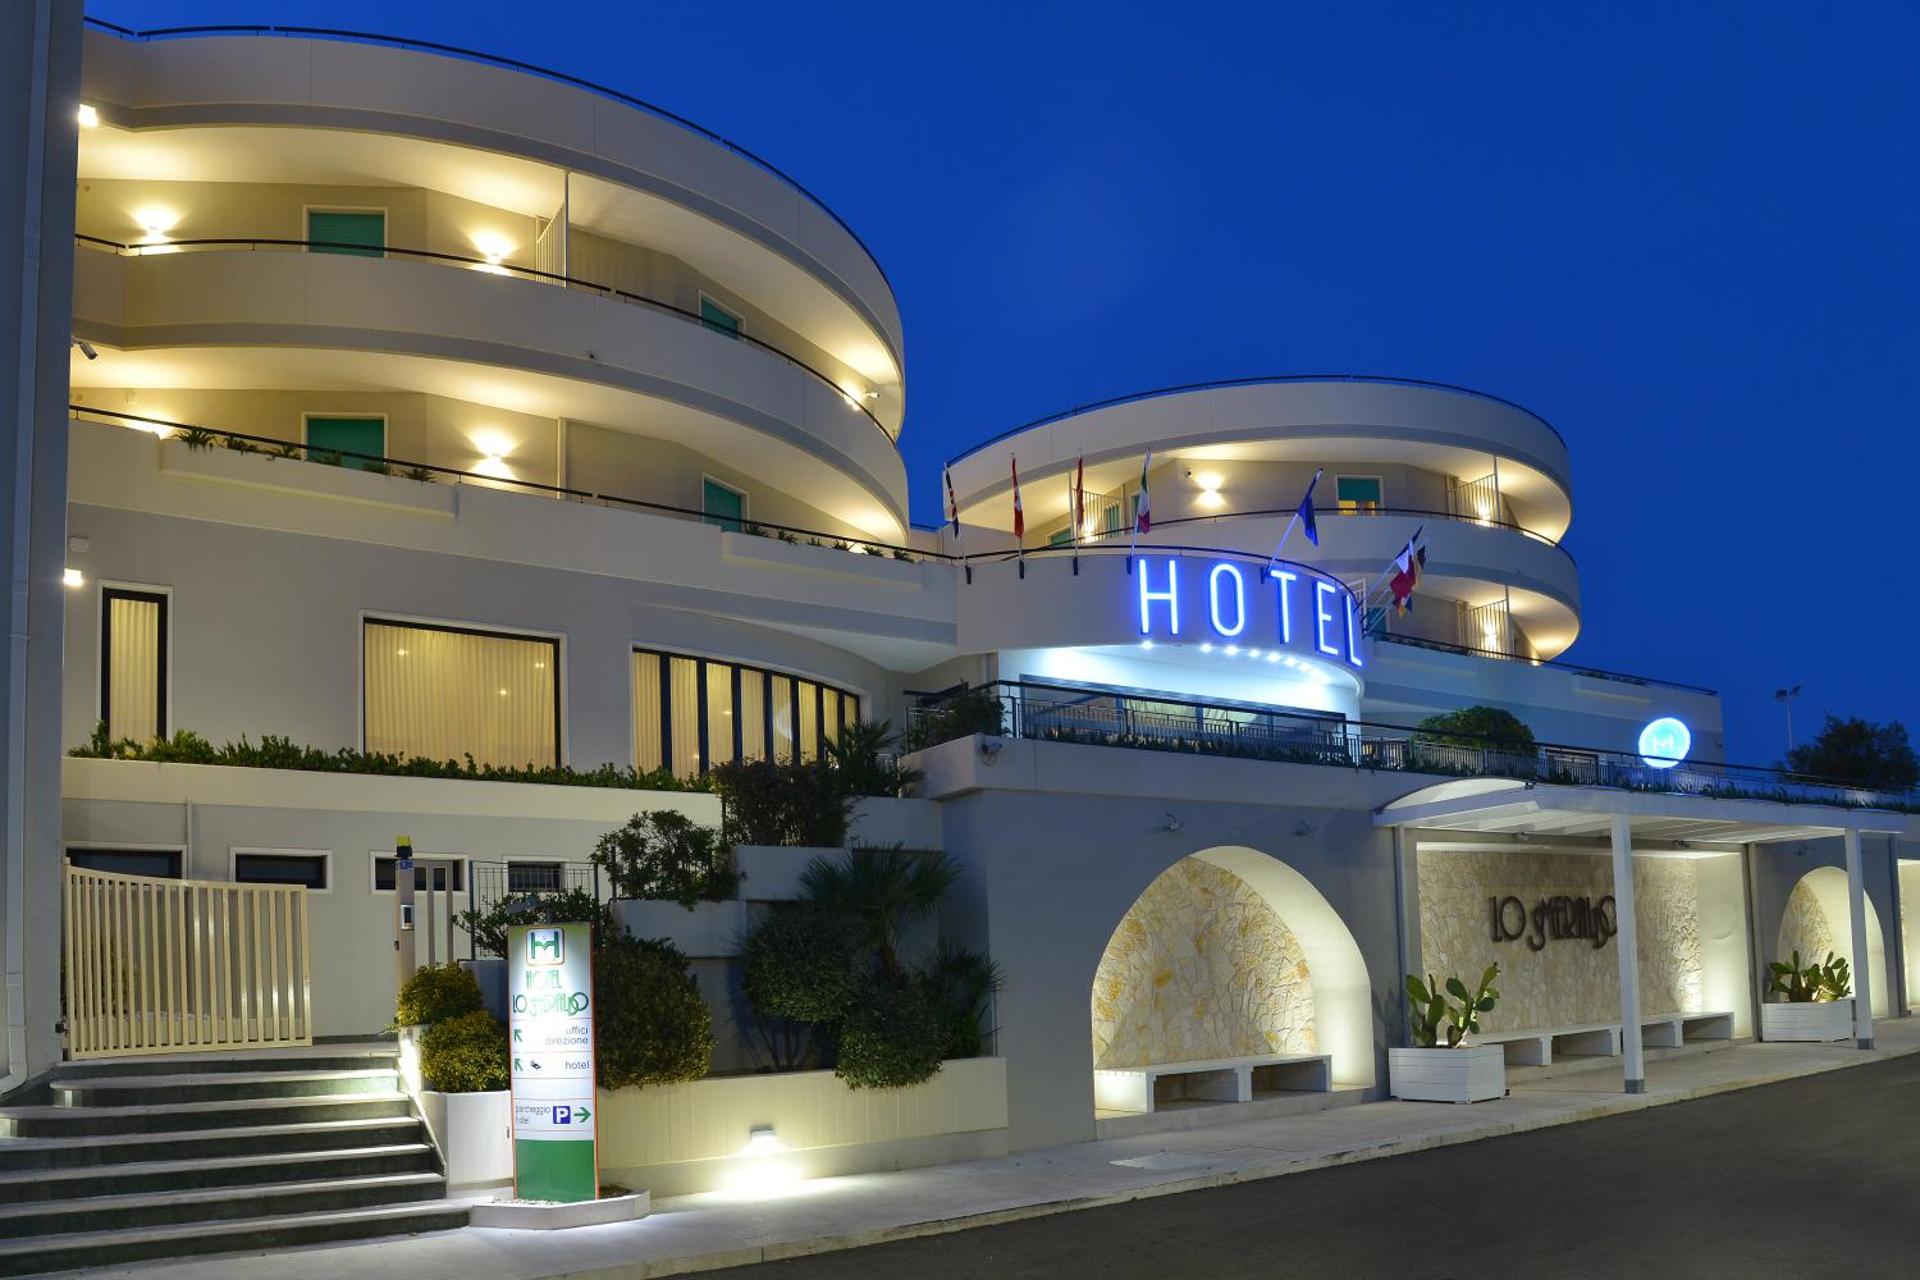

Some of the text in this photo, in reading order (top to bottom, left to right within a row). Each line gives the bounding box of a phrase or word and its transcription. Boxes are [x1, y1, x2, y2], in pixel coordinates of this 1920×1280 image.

[1138, 559, 1362, 667] HOTEL
[512, 994, 527, 1013] LO
[565, 1026, 588, 1035] uffici
[545, 1036, 589, 1045] direzione
[565, 1060, 590, 1070] hotel
[556, 1107, 569, 1124] P
